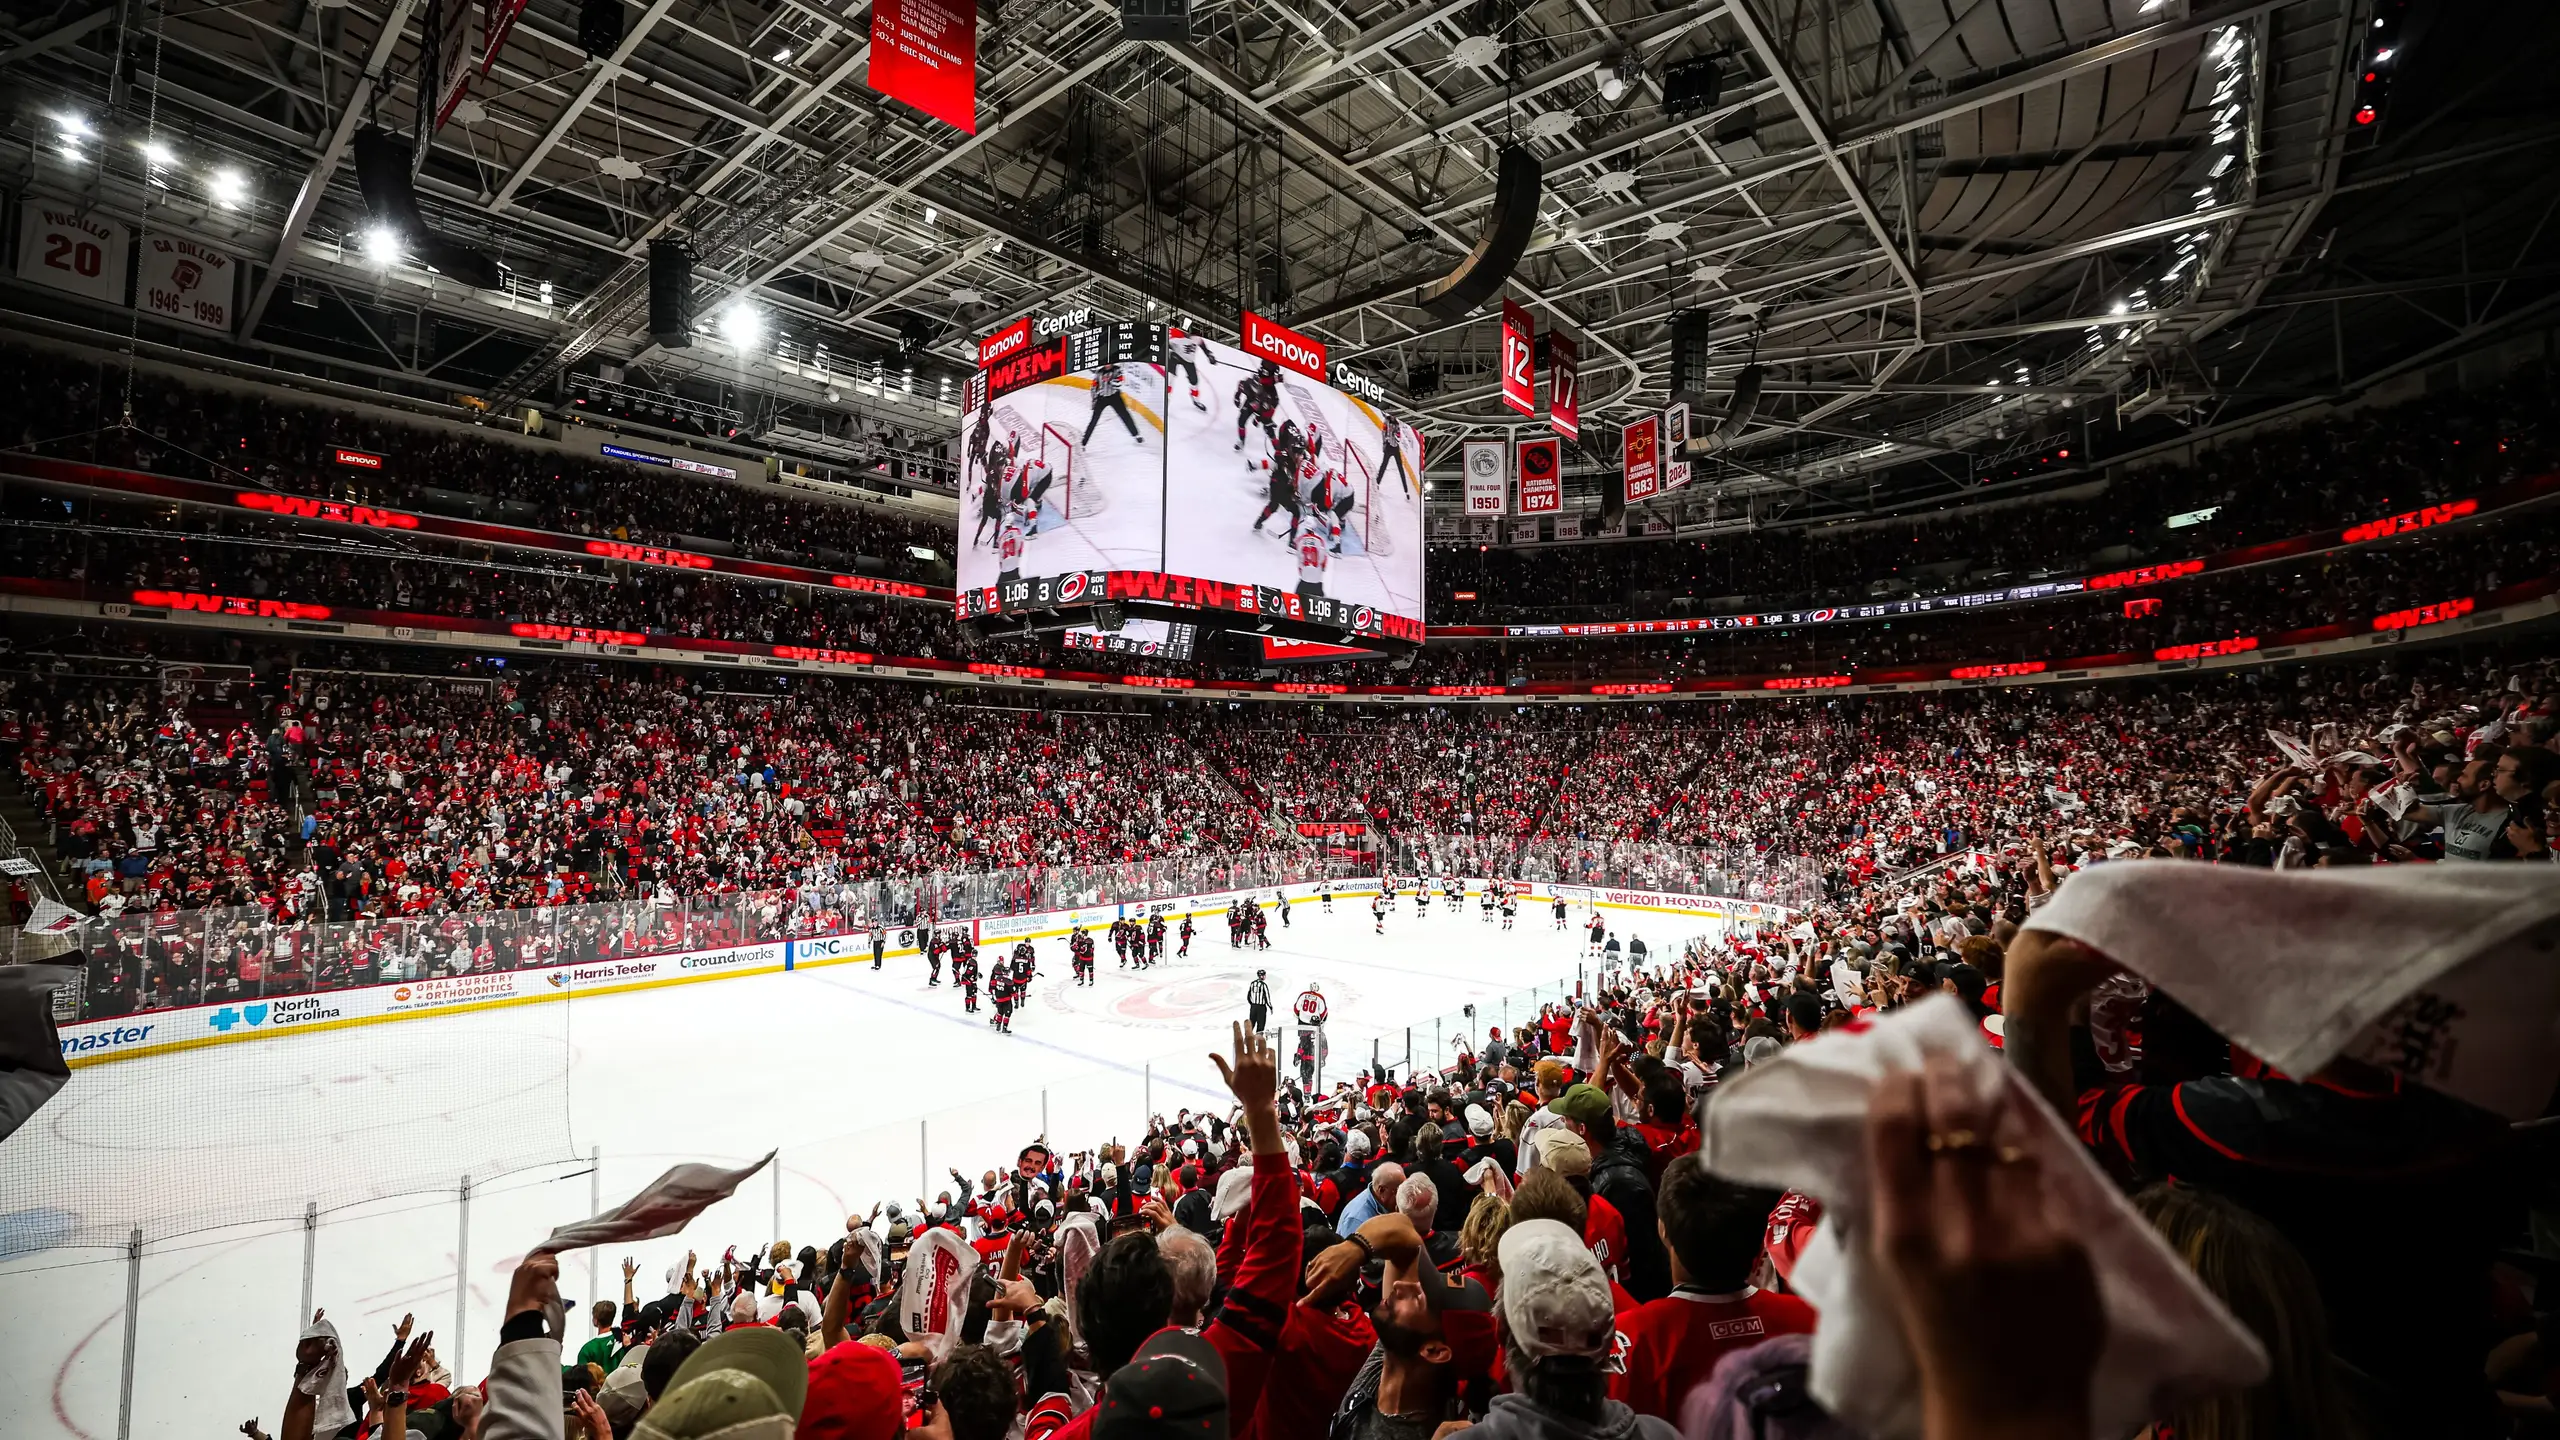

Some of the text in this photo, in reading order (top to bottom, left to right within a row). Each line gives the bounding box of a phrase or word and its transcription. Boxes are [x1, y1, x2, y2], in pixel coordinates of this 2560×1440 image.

[901, 4, 947, 34] GLEN WESLEY
[918, 4, 947, 26] FRANCIS
[901, 13, 938, 39] CAM WARD
[876, 14, 962, 65] 2023 JUSTIN WILLIAMS
[876, 28, 939, 70] 2024 ERIC STAAL
[44, 233, 102, 278] 20
[178, 241, 226, 270] DILLON
[149, 287, 223, 325] 1946 1999
[982, 307, 1092, 361] Lenovo Center
[994, 349, 1053, 389] WIN
[1252, 322, 1385, 402] Lenovo Center
[1507, 335, 1530, 388] 12
[1554, 364, 1575, 409] 17
[340, 453, 378, 466] Lenovo
[610, 449, 671, 465] FANDUEL SPORTS NETWORK
[1628, 467, 1655, 480] CHAMPIONS
[1630, 461, 1652, 472] NATIONAL
[1668, 463, 1688, 483] 2024
[1523, 485, 1557, 494] CHAMPIONS
[1525, 478, 1553, 487] NATIONAL
[1630, 477, 1654, 497] 1983
[1472, 497, 1500, 509] 1950
[1526, 494, 1554, 509] 1974
[270, 493, 389, 529] WIN
[2361, 503, 2452, 541] WIN
[1516, 530, 1535, 540] 1983
[1559, 526, 1579, 537] 1985
[608, 541, 693, 568] WIN
[1091, 575, 1105, 583] SOG
[2105, 561, 2183, 589] WIN
[849, 576, 910, 597] WIN
[1091, 584, 1105, 596] 41
[1122, 570, 1223, 607] WIN
[1240, 588, 1253, 596] SOG
[989, 582, 1050, 608] 2 1:06 3
[1240, 597, 1253, 609] 36
[108, 605, 126, 615] 116
[167, 591, 299, 619] WIN
[958, 604, 966, 617] 36
[1290, 598, 1348, 624] 2 1:06 3
[1745, 613, 1800, 625] 2 1:06 3
[2389, 599, 2461, 630] WIN
[397, 627, 411, 637] 117
[535, 623, 622, 645] WIN
[1373, 621, 1382, 631] 41
[605, 644, 617, 653] 118
[1095, 638, 1137, 653] 2 1:06 3
[750, 656, 761, 664] 119
[791, 645, 855, 665] WIN
[981, 663, 1032, 678] WIN
[1134, 675, 1182, 688] WIN
[1284, 683, 1334, 694] WIN
[1604, 683, 1657, 695] WIN
[1777, 676, 1837, 689] WIN
[1441, 686, 1492, 696] WIN
[1605, 891, 1660, 907] verizon
[1664, 896, 1722, 909] HONDA
[1150, 902, 1176, 914] PEPSI
[984, 915, 1049, 931] RALEIGH ORTHOPAEDIC
[1080, 914, 1103, 924] Lottery
[899, 934, 914, 944] LBC
[800, 940, 840, 958] UNC
[680, 948, 774, 968] Groundworks
[574, 962, 657, 981] Harris Teeter
[1018, 962, 1025, 974] 5
[416, 974, 514, 992] ORAL SURGERY
[425, 982, 513, 1000] ORTHODONTICS
[273, 998, 320, 1013] North
[1302, 999, 1317, 1014] 80
[273, 1007, 340, 1024] Carolina
[1715, 1320, 1760, 1335] CCM
